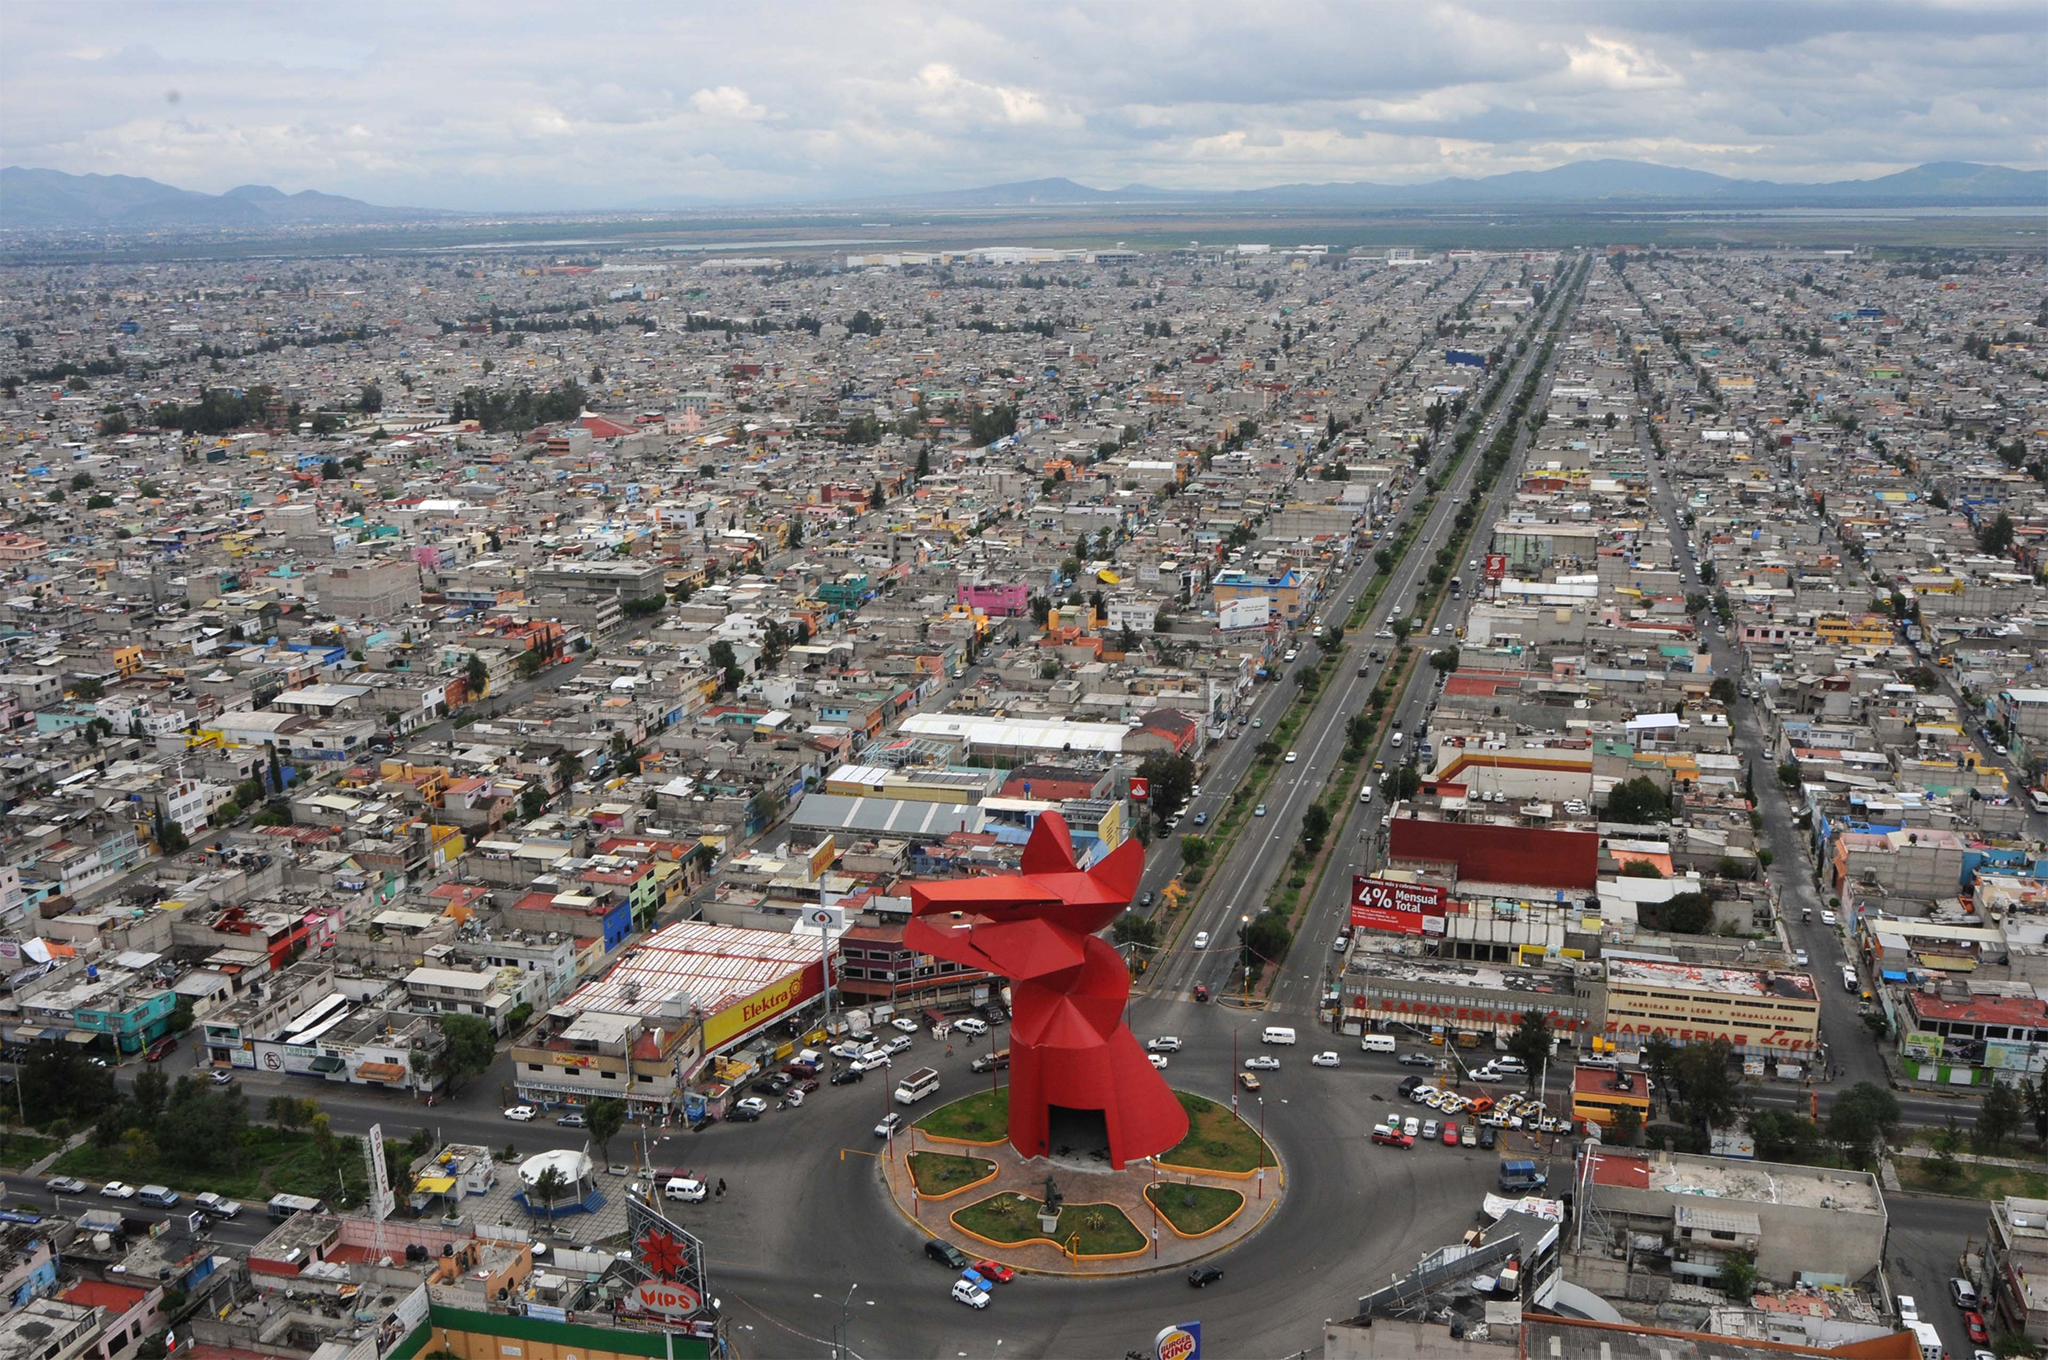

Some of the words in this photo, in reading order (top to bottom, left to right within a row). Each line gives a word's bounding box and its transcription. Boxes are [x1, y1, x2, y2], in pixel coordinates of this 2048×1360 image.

[1291, 548, 1311, 556] HOTEL
[1359, 877, 1384, 886] Prestamos
[1399, 883, 1421, 891] cobramos
[1358, 886, 1393, 909] 4%
[1395, 890, 1437, 905] Mensual
[1395, 900, 1421, 913] Total
[742, 988, 789, 1022] Elektra
[1381, 999, 1525, 1024] ZAPATERIAS
[1627, 1001, 1670, 1011] FABRICAS
[1691, 1007, 1713, 1015] LEON
[1730, 1011, 1795, 1023] GUADALAJARA
[1605, 1021, 1748, 1046] ZAPATERIAS
[374, 1130, 388, 1196] OPTICA
[639, 1288, 691, 1310] VIPS
[1160, 1335, 1191, 1354] BURGER
[1162, 1341, 1192, 1360] KING
